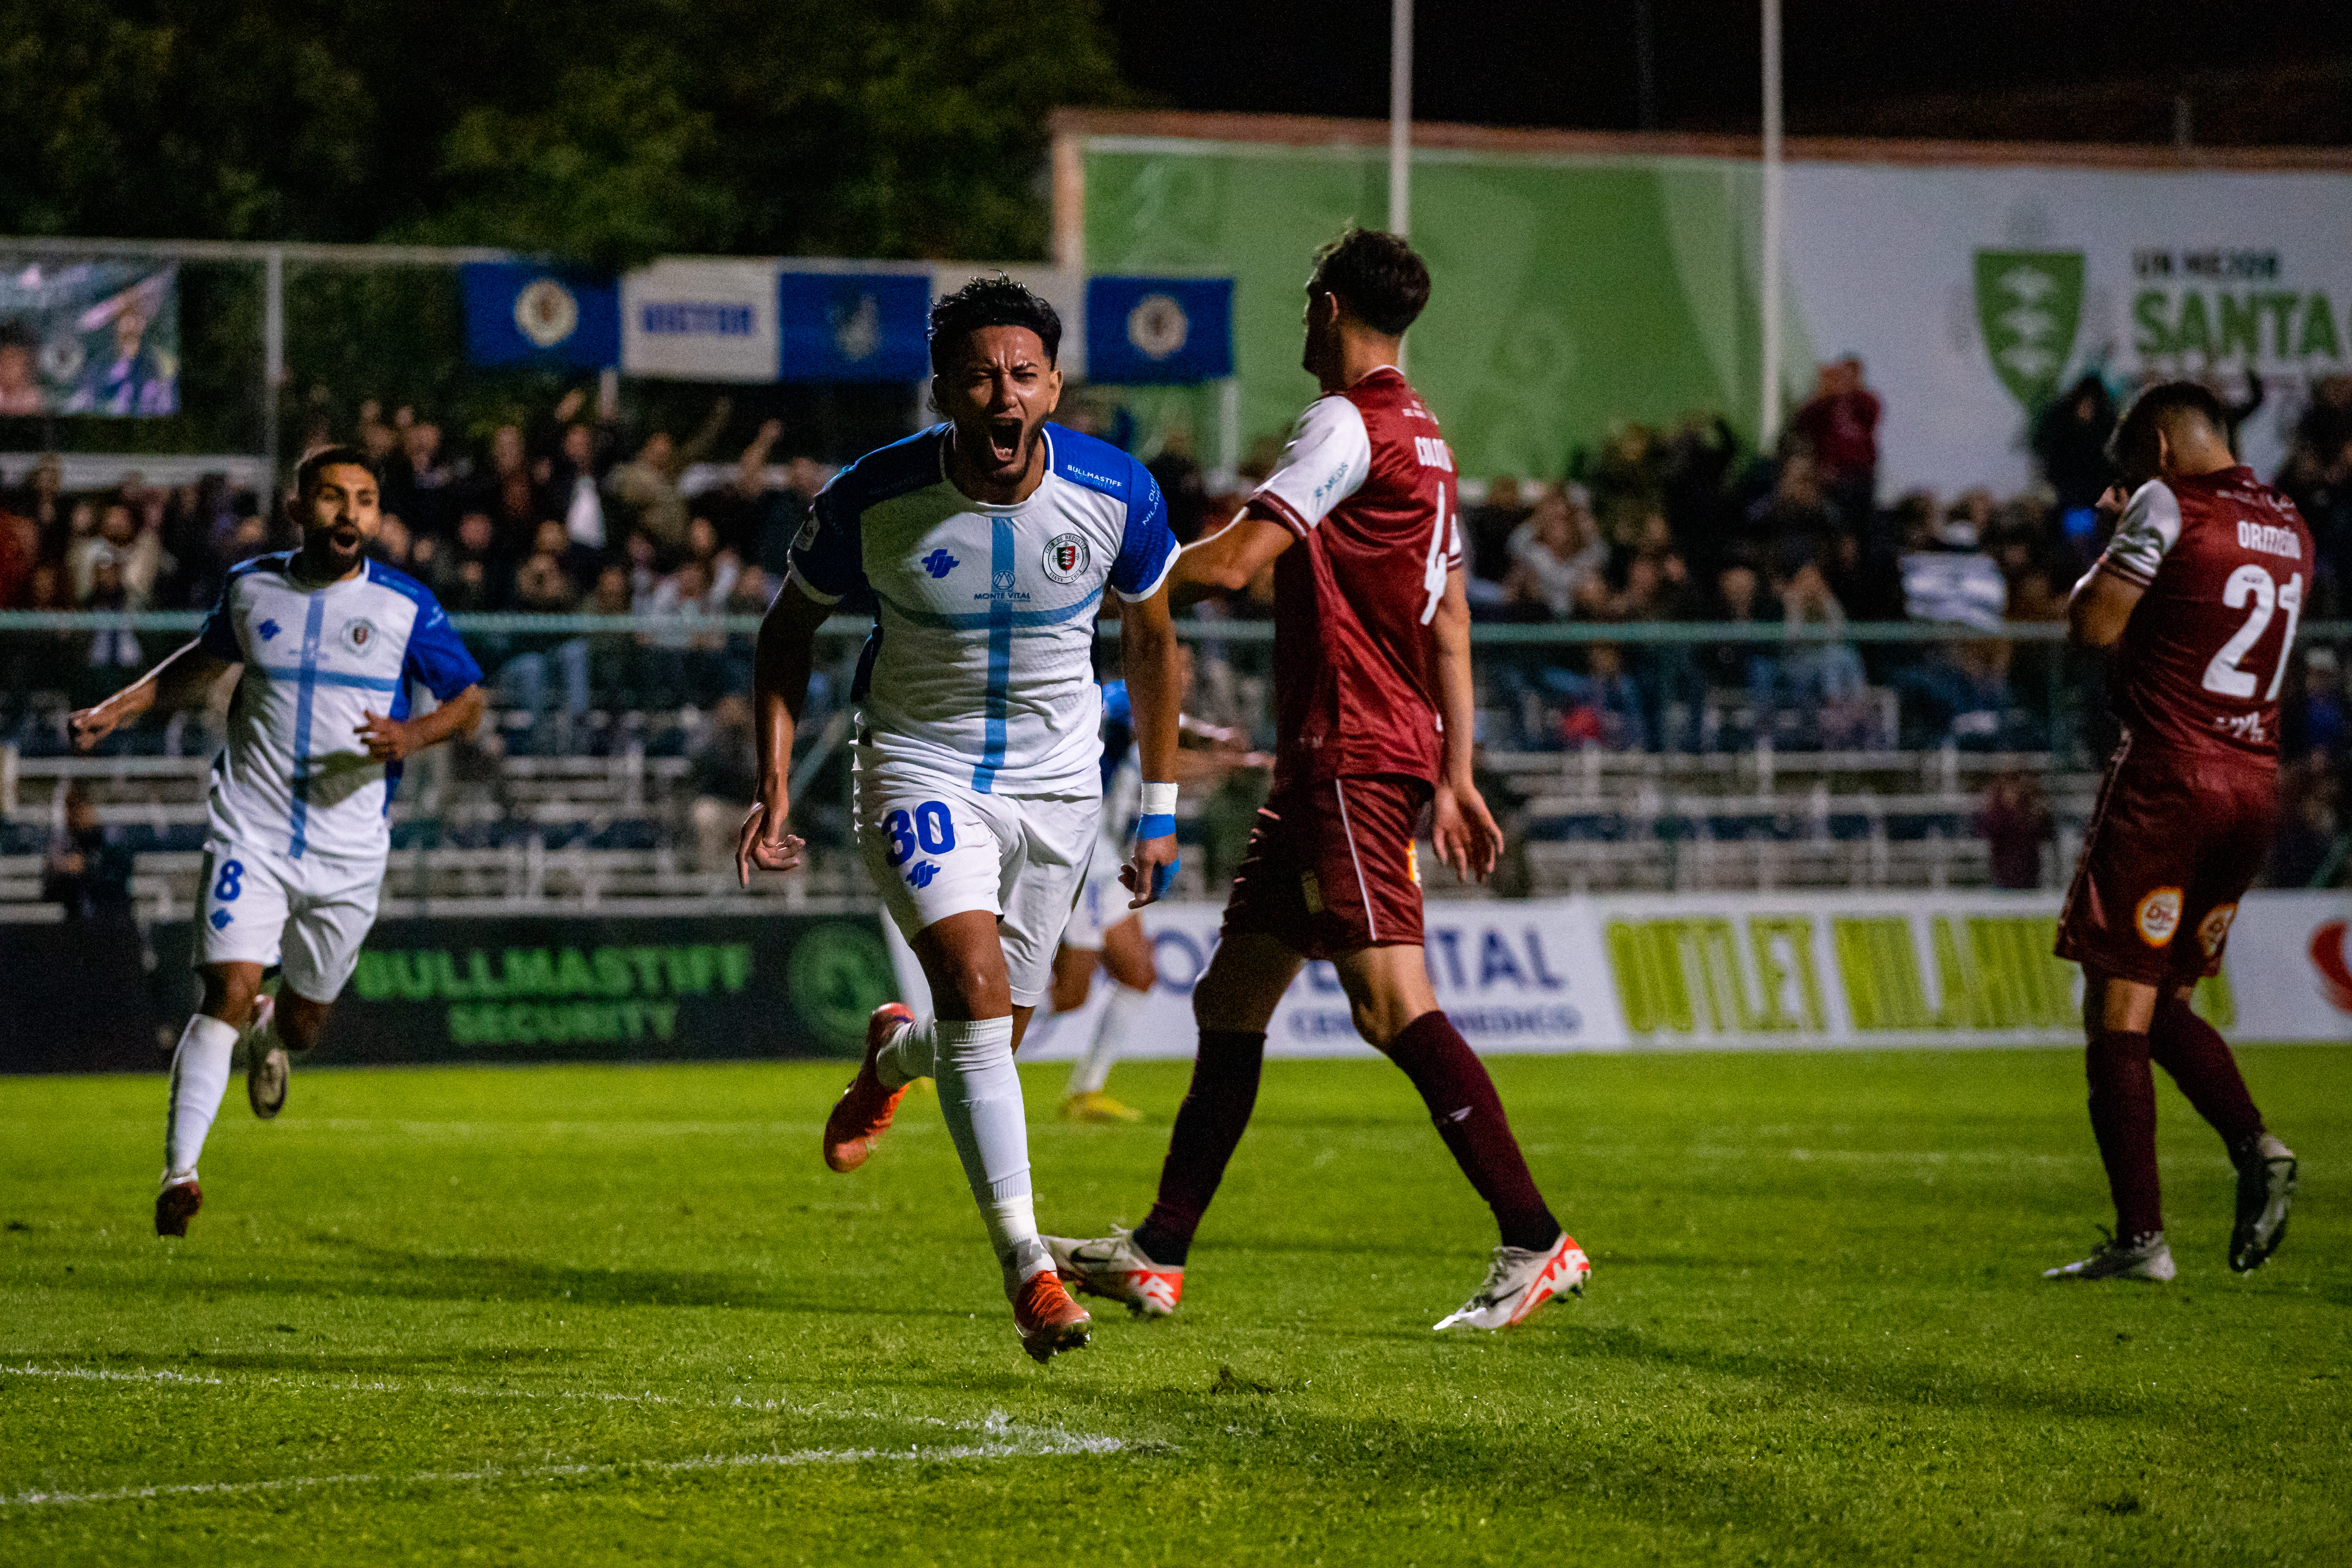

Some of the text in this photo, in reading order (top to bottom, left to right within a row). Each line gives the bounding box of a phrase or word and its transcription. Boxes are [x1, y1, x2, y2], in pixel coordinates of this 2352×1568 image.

[2133, 292, 2340, 356] SANTA
[1067, 464, 1122, 487] BULLMASTIFF
[1074, 473, 1114, 489] SECURITY
[1420, 482, 1447, 625] 4
[2202, 564, 2303, 701] 21
[882, 801, 956, 868] 30
[215, 860, 243, 901] 8
[355, 947, 753, 1001] BULLMASTIFF
[448, 999, 677, 1045] SECURITY
